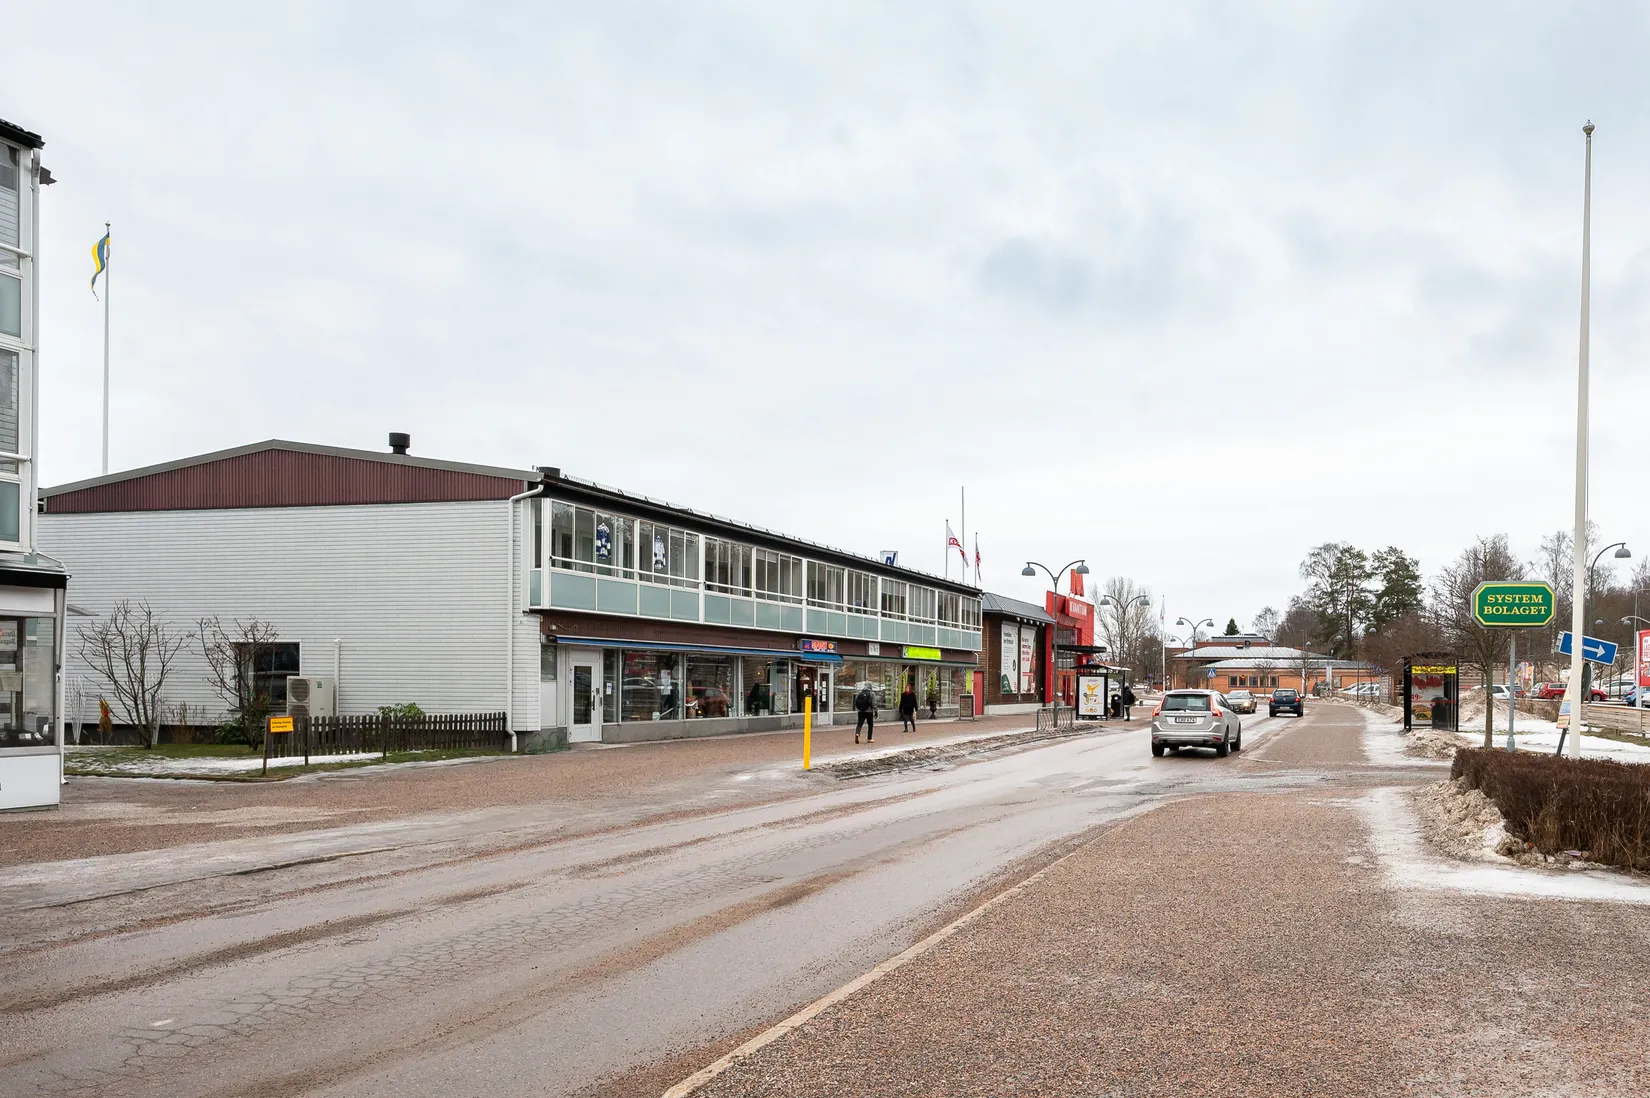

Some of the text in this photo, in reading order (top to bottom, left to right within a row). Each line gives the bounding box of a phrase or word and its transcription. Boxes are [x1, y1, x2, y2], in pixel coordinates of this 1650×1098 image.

[1487, 594, 1543, 603] SYSTEM
[1069, 600, 1088, 616] KVANTUM
[1483, 606, 1547, 615] BOLAGET
